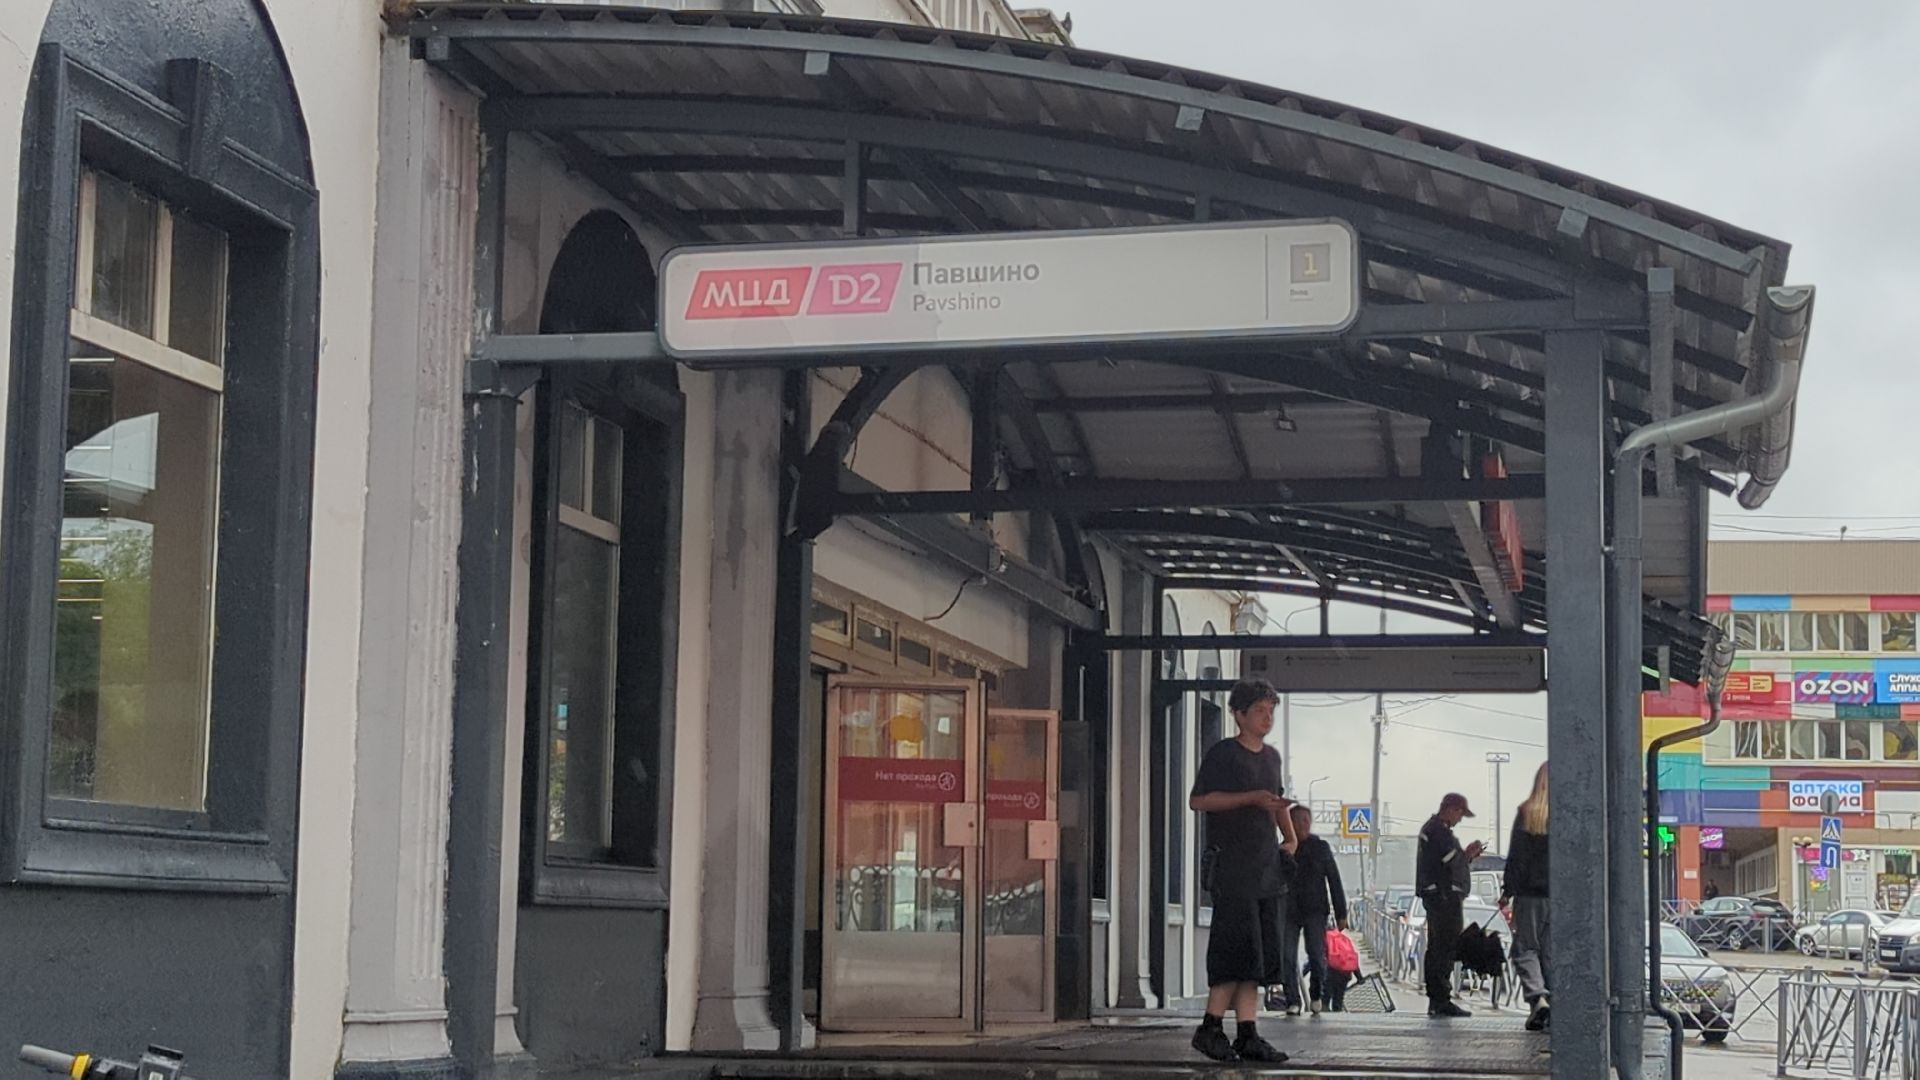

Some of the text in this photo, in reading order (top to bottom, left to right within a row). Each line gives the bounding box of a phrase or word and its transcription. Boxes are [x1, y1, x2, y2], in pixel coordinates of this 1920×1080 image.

[913, 262, 1040, 285] Павшино
[1303, 252, 1318, 275] 1
[702, 279, 791, 308] МЦД
[828, 273, 882, 306] D2
[913, 291, 1001, 312] Pavshino
[1800, 679, 1869, 695] OZON
[1889, 684, 1920, 693] АППА
[875, 770, 893, 781] Нет
[1792, 783, 1860, 794] аптека
